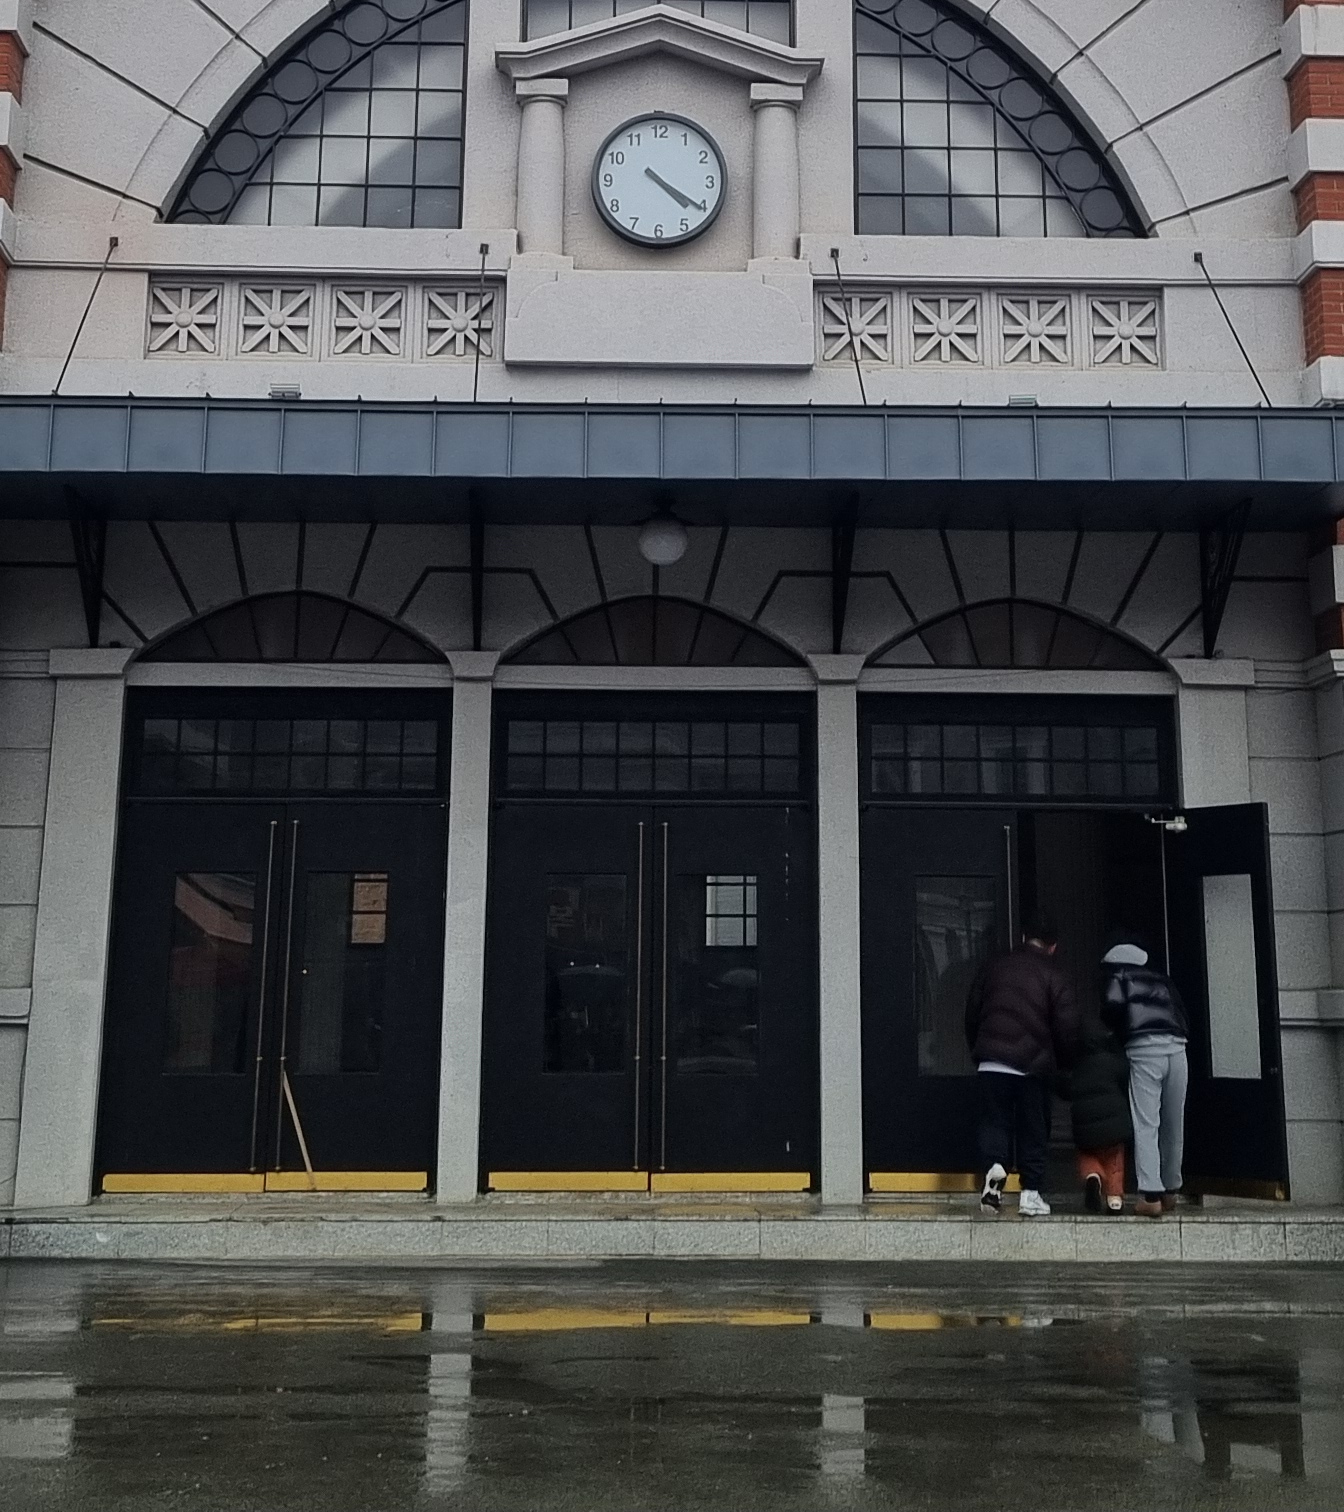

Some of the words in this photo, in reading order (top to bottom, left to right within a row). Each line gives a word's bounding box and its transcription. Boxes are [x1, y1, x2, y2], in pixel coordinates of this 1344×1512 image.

[651, 125, 668, 138] 12
[627, 133, 641, 146] 11
[681, 133, 688, 146] 1
[608, 151, 624, 164] 10
[699, 150, 708, 164] 2
[603, 173, 613, 187] 9
[705, 176, 715, 189] 3
[610, 199, 619, 212] 8
[629, 217, 639, 230] 7
[679, 218, 689, 232] 5
[654, 224, 663, 238] 6
